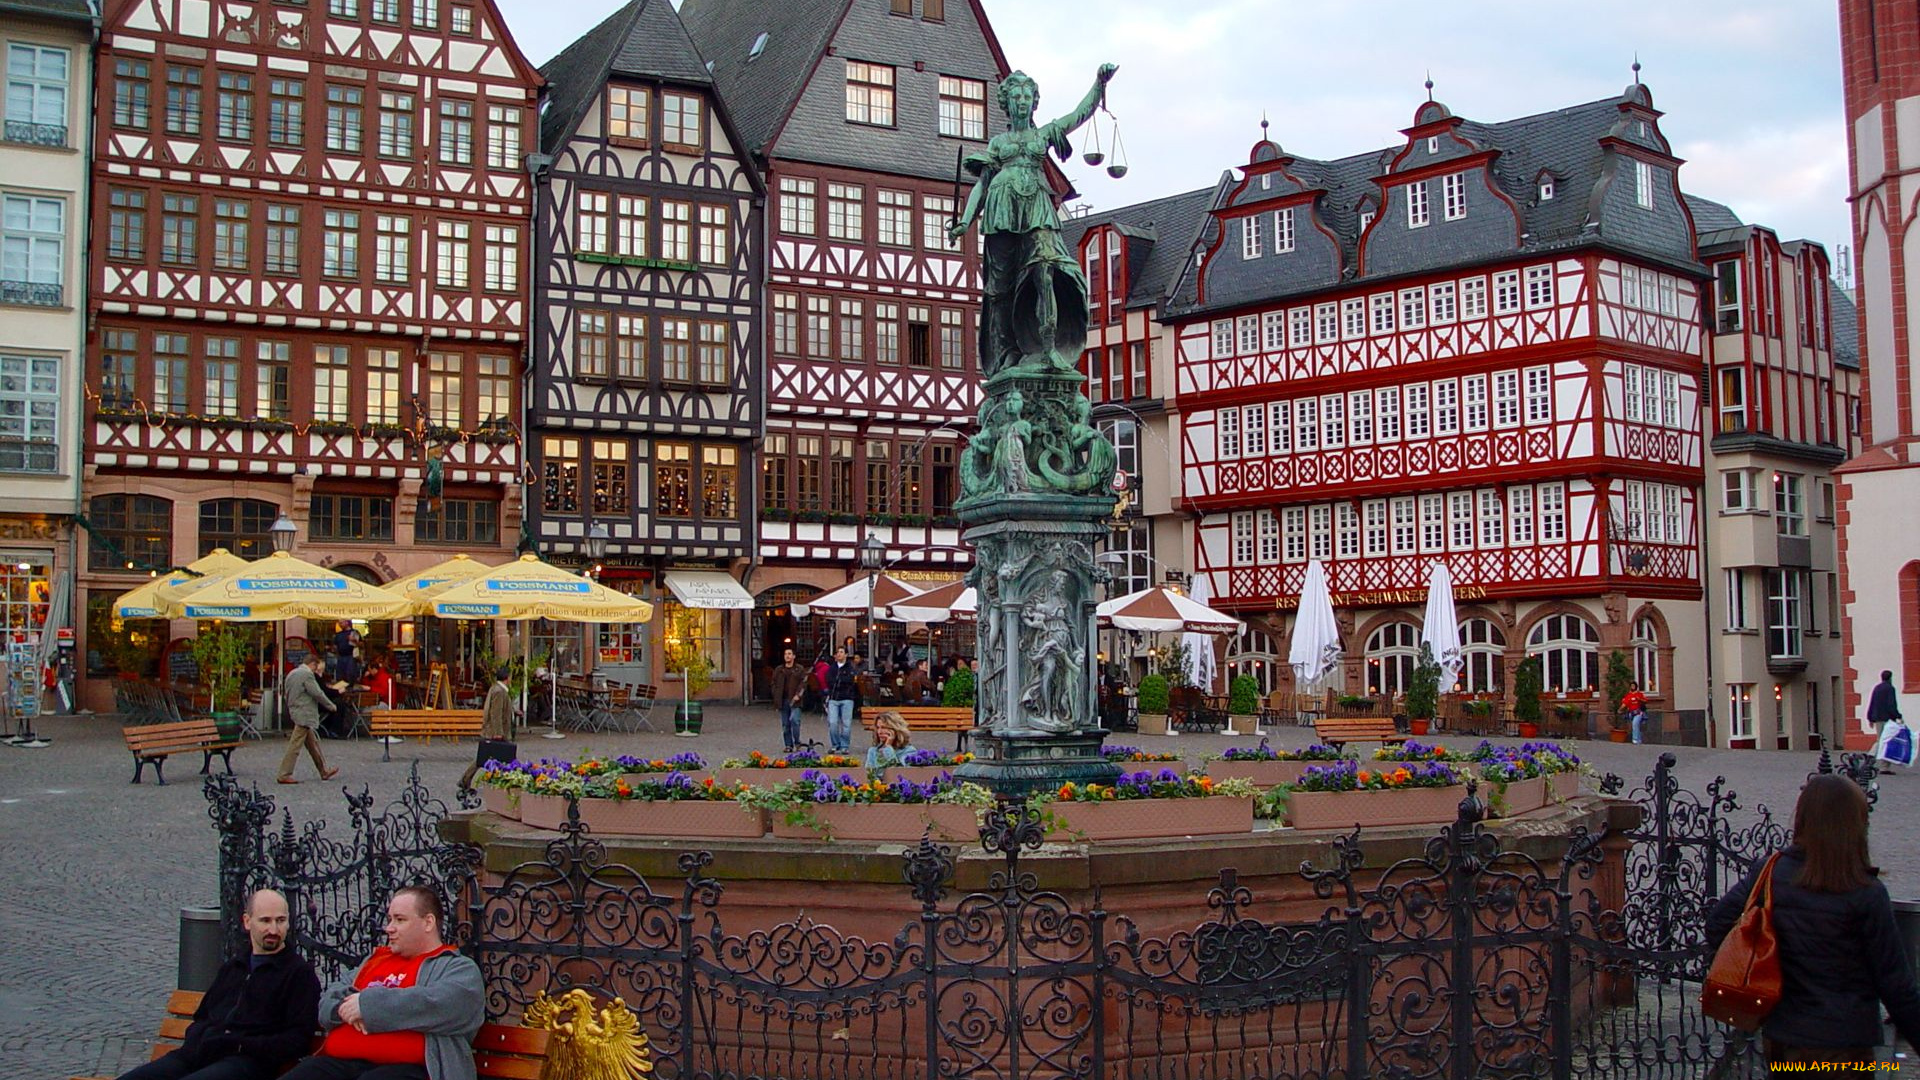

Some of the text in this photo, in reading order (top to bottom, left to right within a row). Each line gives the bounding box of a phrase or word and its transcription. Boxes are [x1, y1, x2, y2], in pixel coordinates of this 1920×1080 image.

[250, 580, 336, 589] POSSMANN
[498, 581, 580, 591] POSSMANN
[1358, 589, 1428, 604] SCHWARZE
[193, 607, 244, 616] POSSMANN
[278, 607, 304, 615] Selbst
[308, 607, 346, 616] gekeltert
[348, 607, 364, 615] seit
[444, 605, 494, 614] POSSMANN
[512, 607, 528, 615] Aus
[531, 606, 570, 616] Tradition
[573, 607, 589, 616] und
